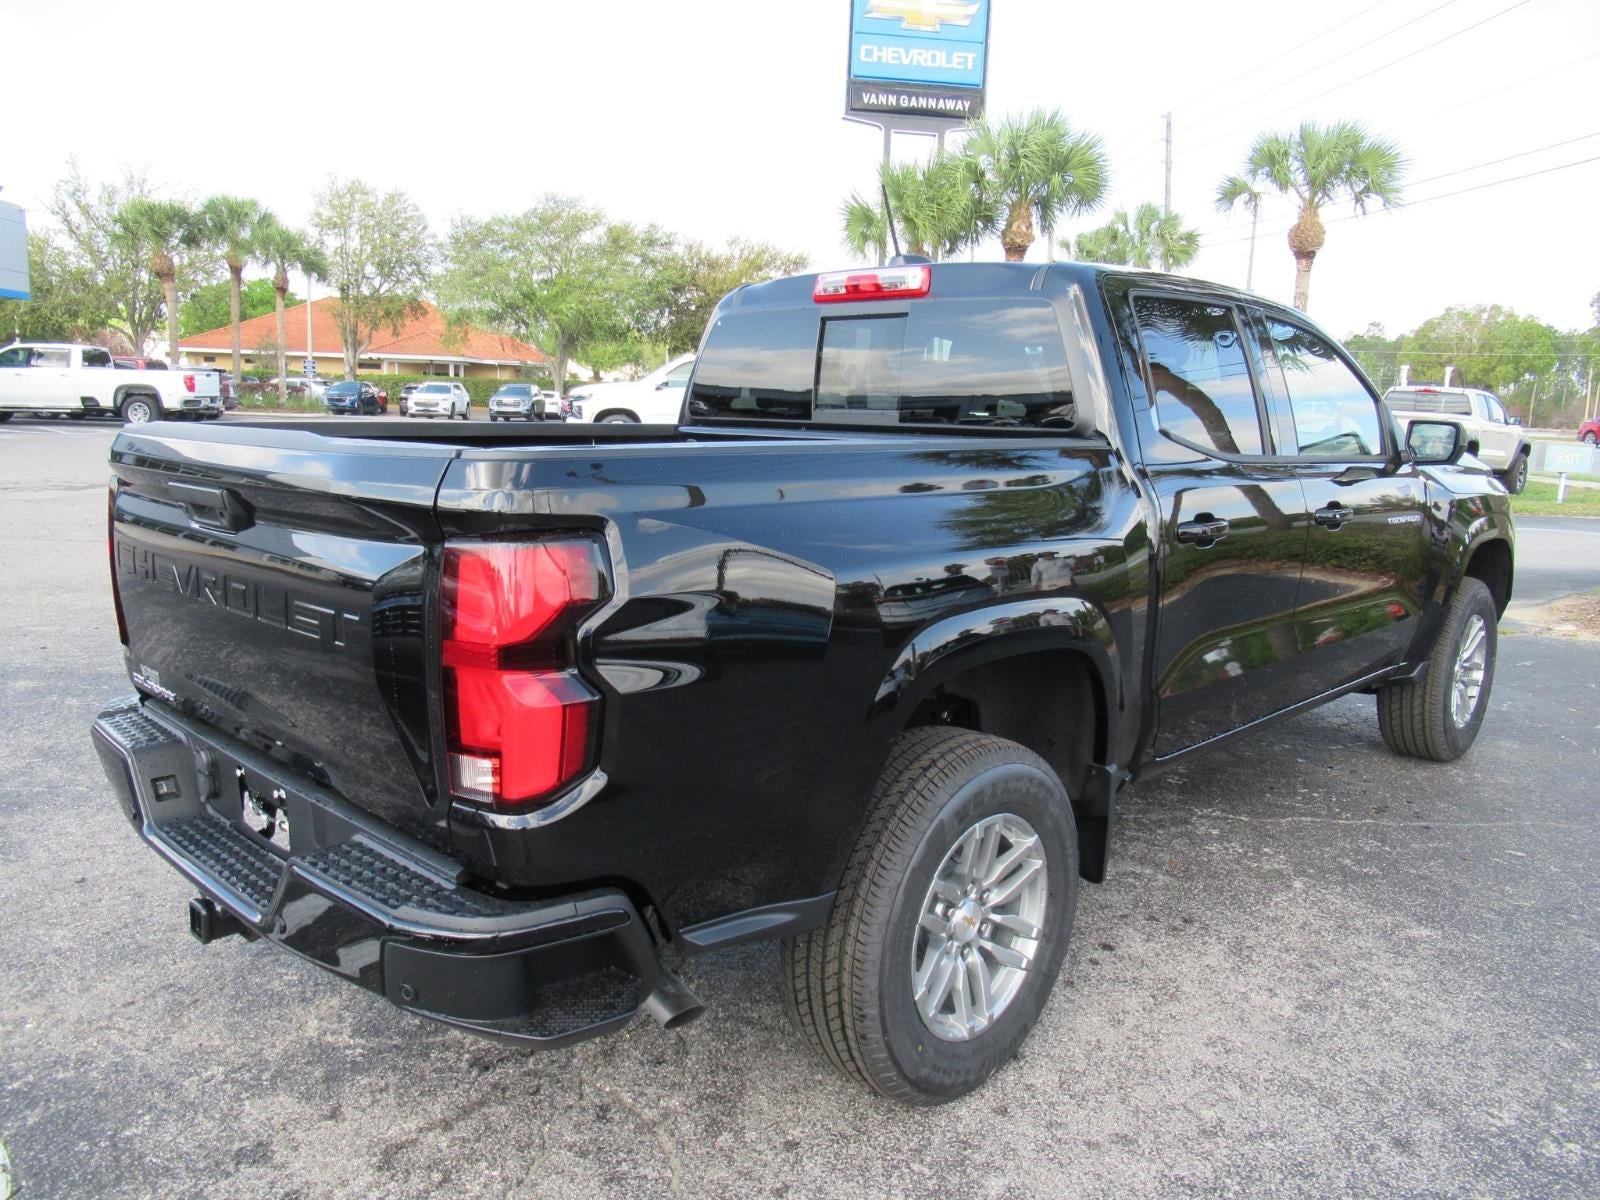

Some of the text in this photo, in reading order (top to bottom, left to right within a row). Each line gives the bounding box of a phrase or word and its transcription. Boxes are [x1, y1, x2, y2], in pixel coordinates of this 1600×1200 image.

[860, 44, 977, 70] CHEVROLET
[862, 92, 971, 112] VANN GANNAWAY
